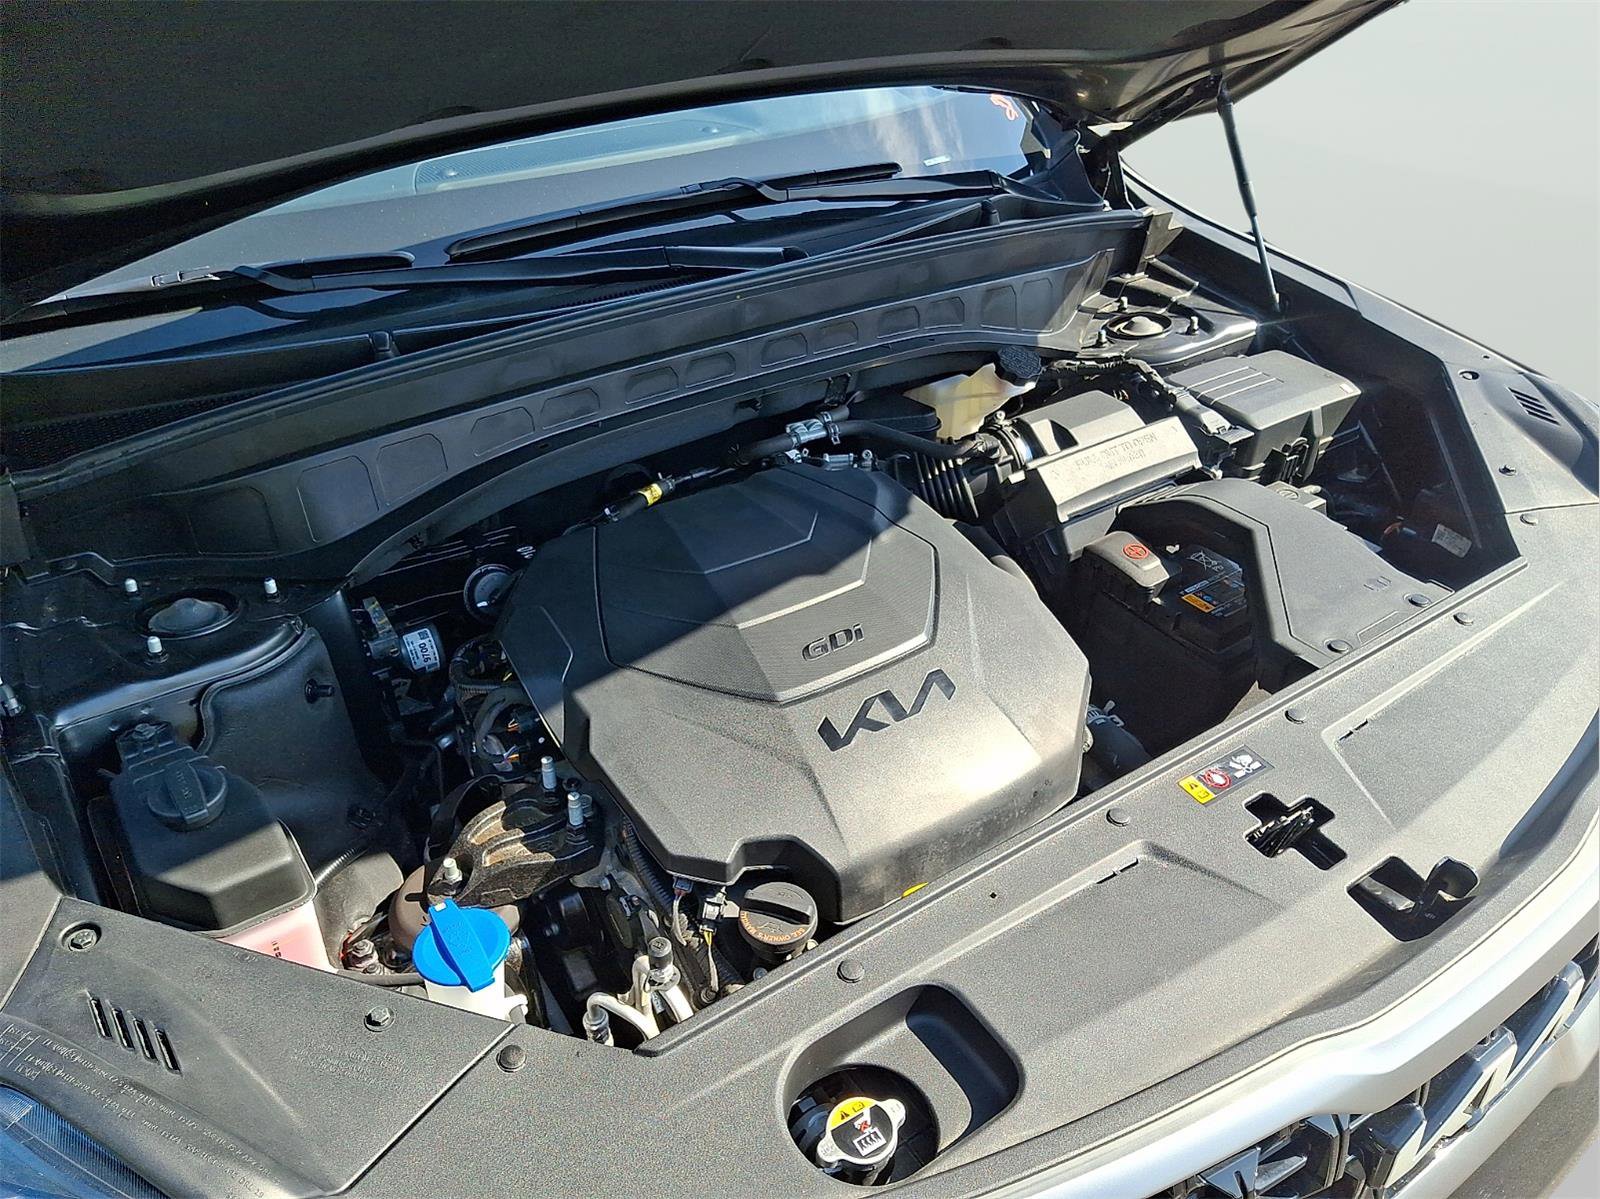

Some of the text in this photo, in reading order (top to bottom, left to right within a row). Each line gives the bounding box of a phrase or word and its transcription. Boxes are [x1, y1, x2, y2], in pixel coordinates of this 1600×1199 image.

[419, 642, 432, 663] 9700
[817, 668, 957, 752] KIA
[758, 931, 791, 942] OWNER'S
[790, 926, 806, 938] SEE
